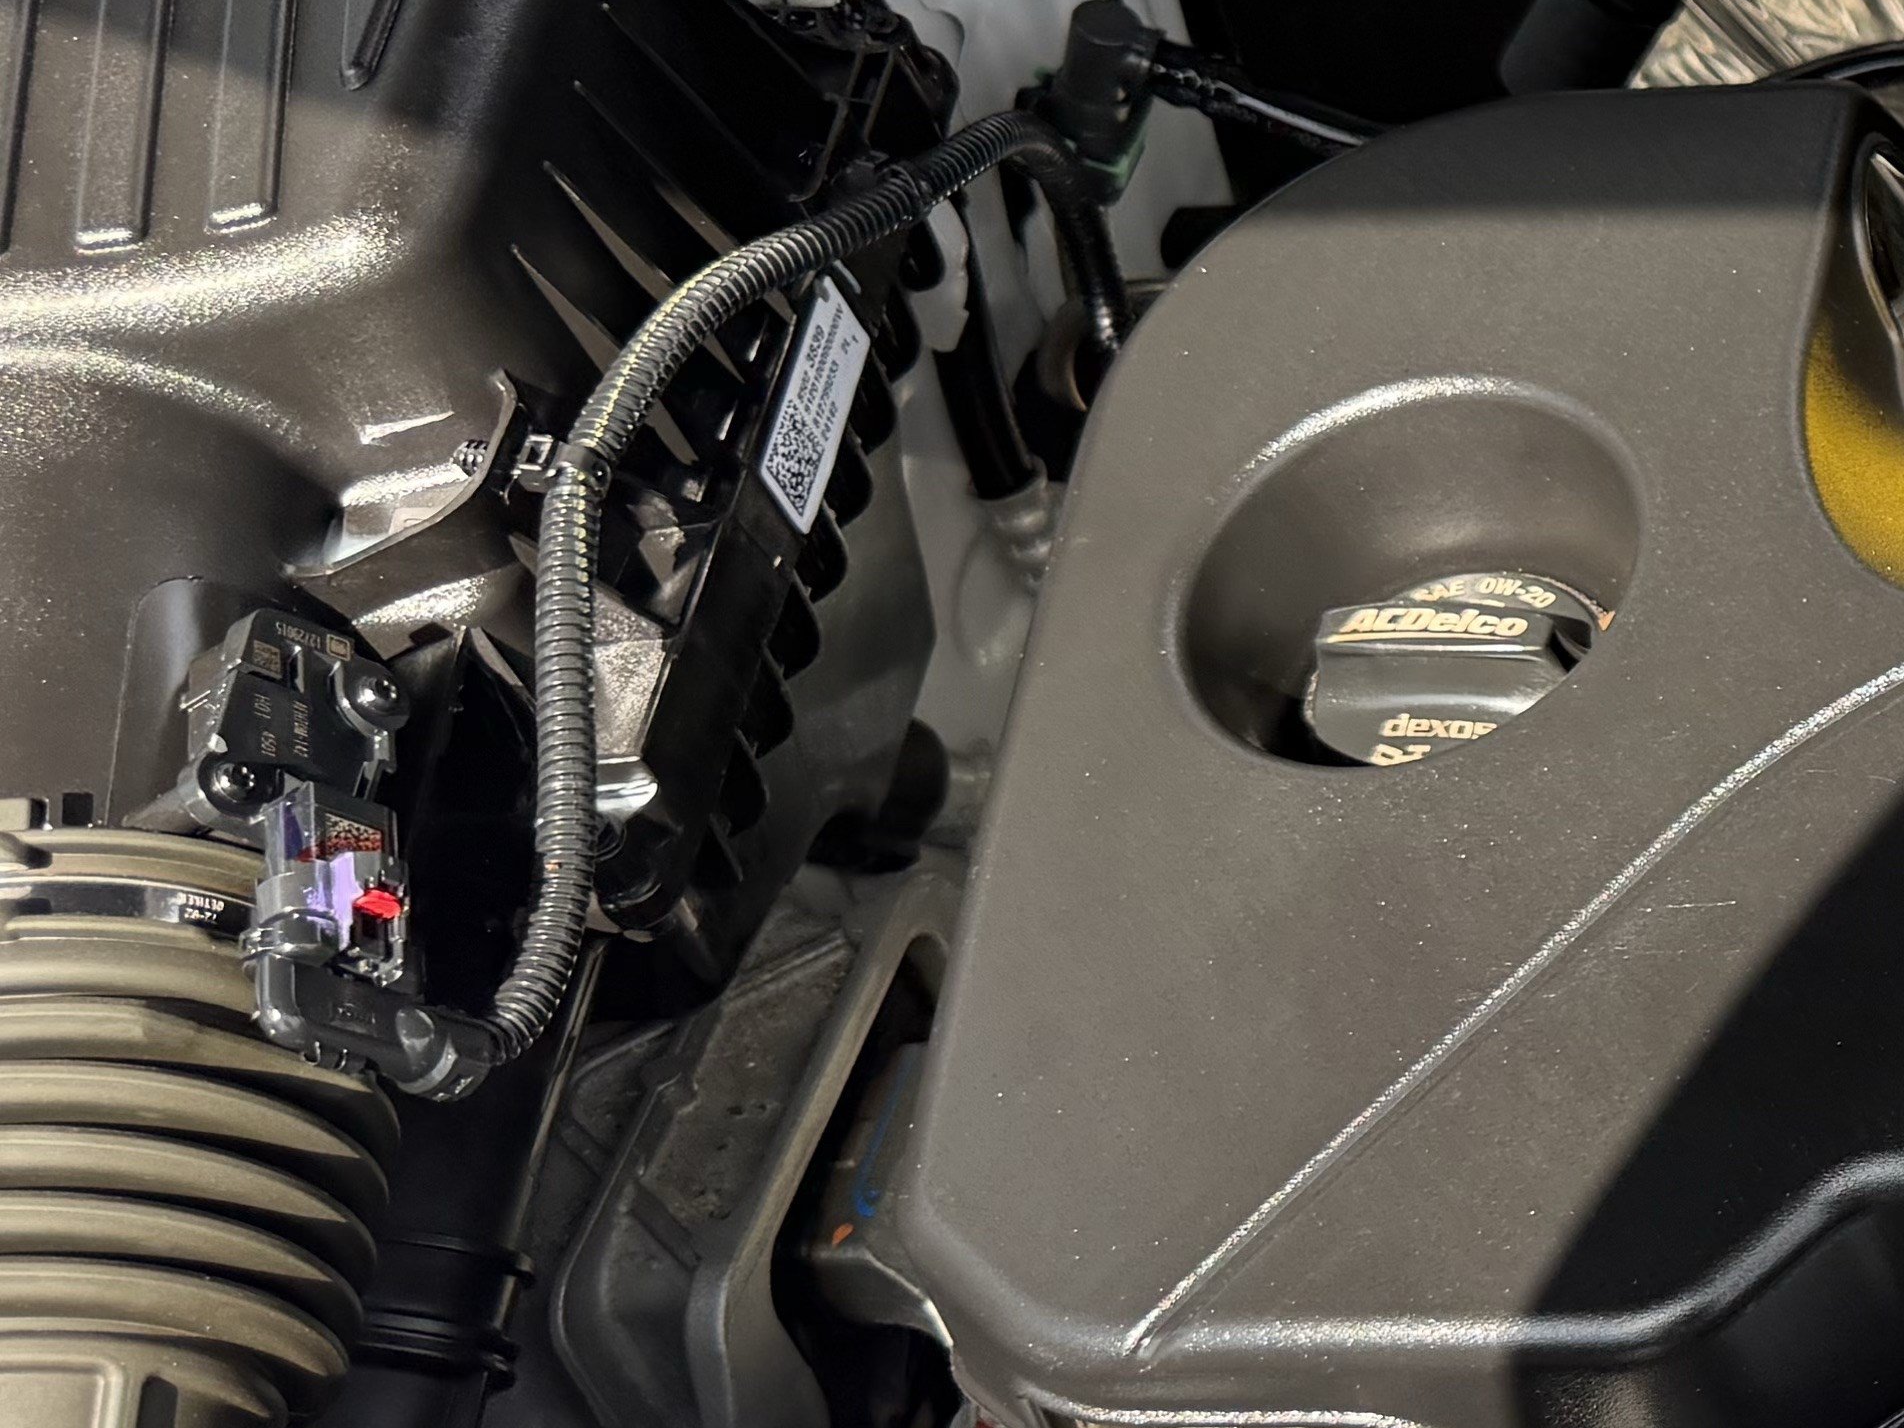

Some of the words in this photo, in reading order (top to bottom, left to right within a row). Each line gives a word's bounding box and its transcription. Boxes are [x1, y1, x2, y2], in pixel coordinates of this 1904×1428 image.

[1410, 578, 1467, 603] SAE
[1476, 576, 1557, 610] 0W-20
[1337, 607, 1530, 638] ACDelco
